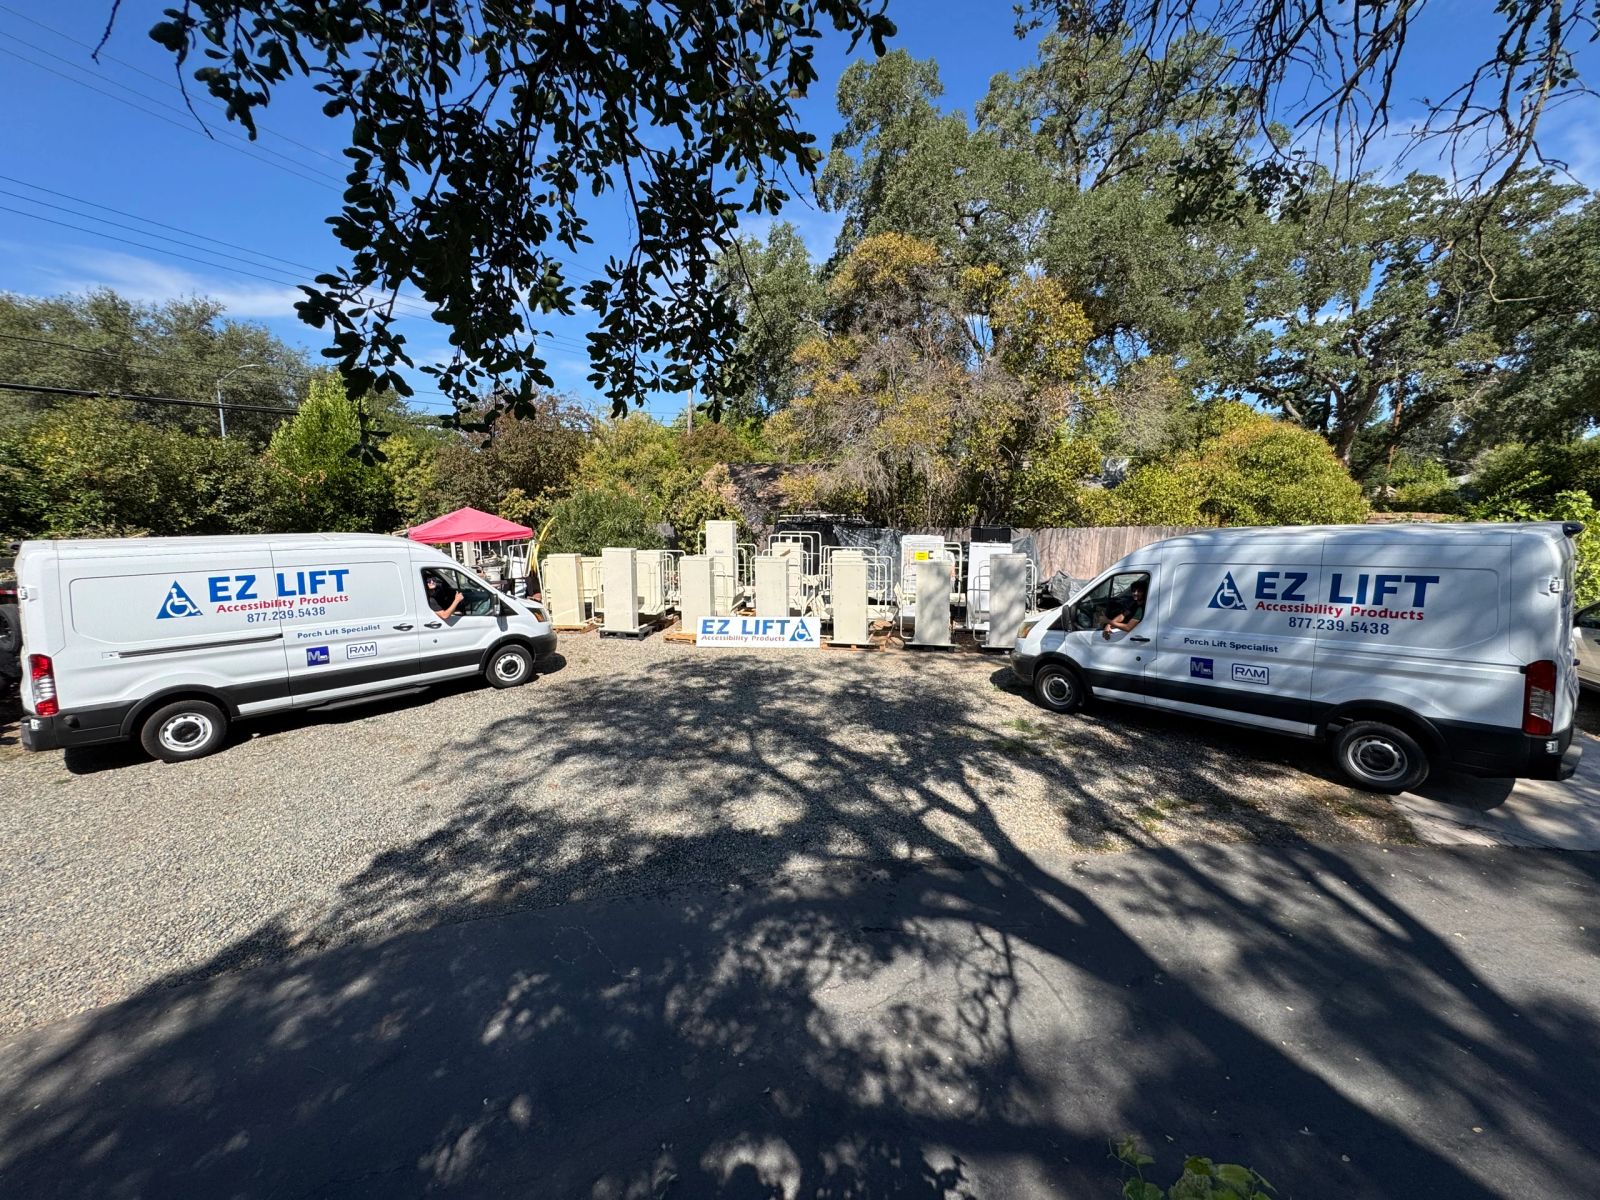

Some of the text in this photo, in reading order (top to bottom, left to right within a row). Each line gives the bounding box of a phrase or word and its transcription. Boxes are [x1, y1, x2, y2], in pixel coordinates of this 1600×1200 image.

[207, 569, 350, 603] EZ LIFT
[1254, 571, 1440, 608] EZ LIFT
[216, 594, 349, 614] Accessibility Products
[1255, 600, 1424, 621] Accessibility Products
[247, 606, 326, 623] 877.239.5438
[297, 624, 381, 639] Porch Lift Specialist
[701, 619, 791, 635] EZ LIFT
[1288, 616, 1390, 635] 877.239.5438
[349, 644, 375, 655] RAM
[1183, 637, 1279, 653] Porch Lift Specialist
[1235, 666, 1266, 679] RAM
